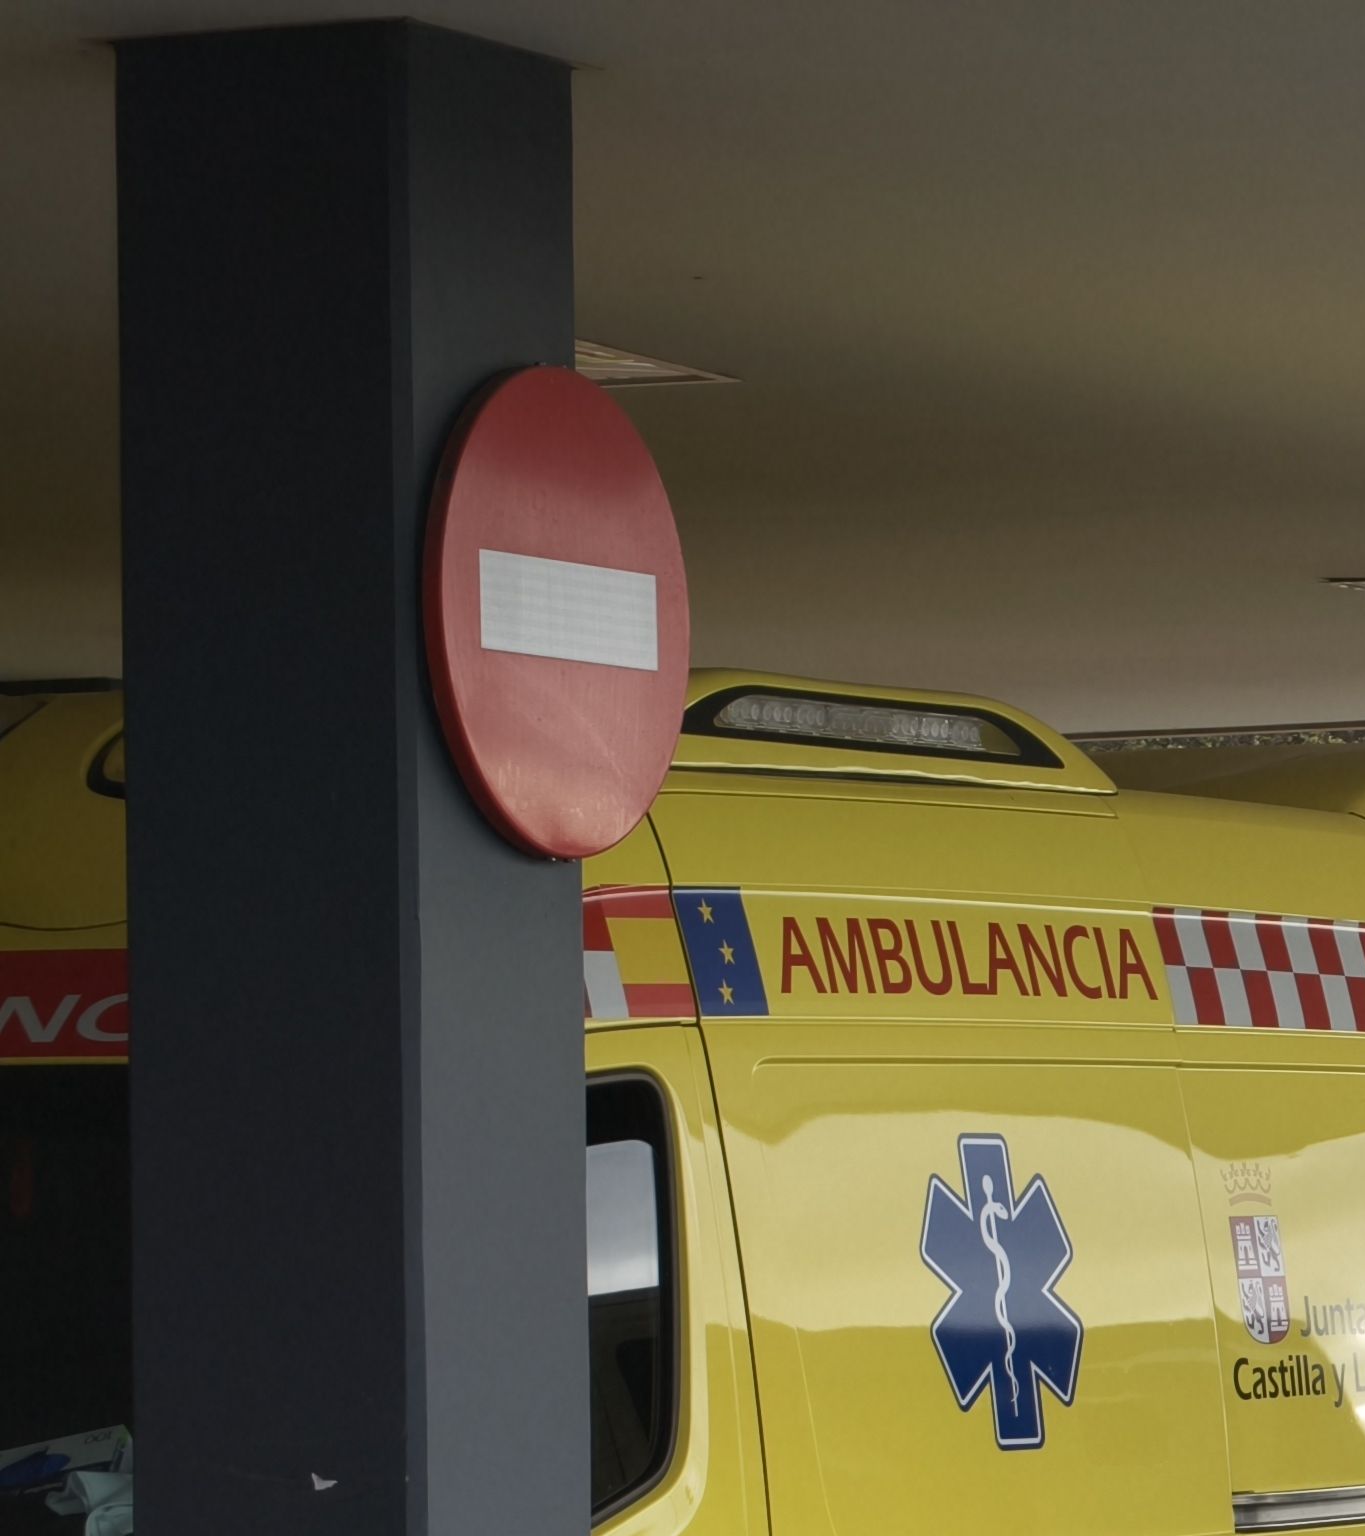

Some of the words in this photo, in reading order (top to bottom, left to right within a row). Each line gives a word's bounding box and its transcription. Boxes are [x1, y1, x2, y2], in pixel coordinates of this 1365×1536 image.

[780, 916, 1159, 1001] AMBULANCIA
[1233, 1354, 1326, 1400] Castilla
[1331, 1362, 1346, 1408] y
